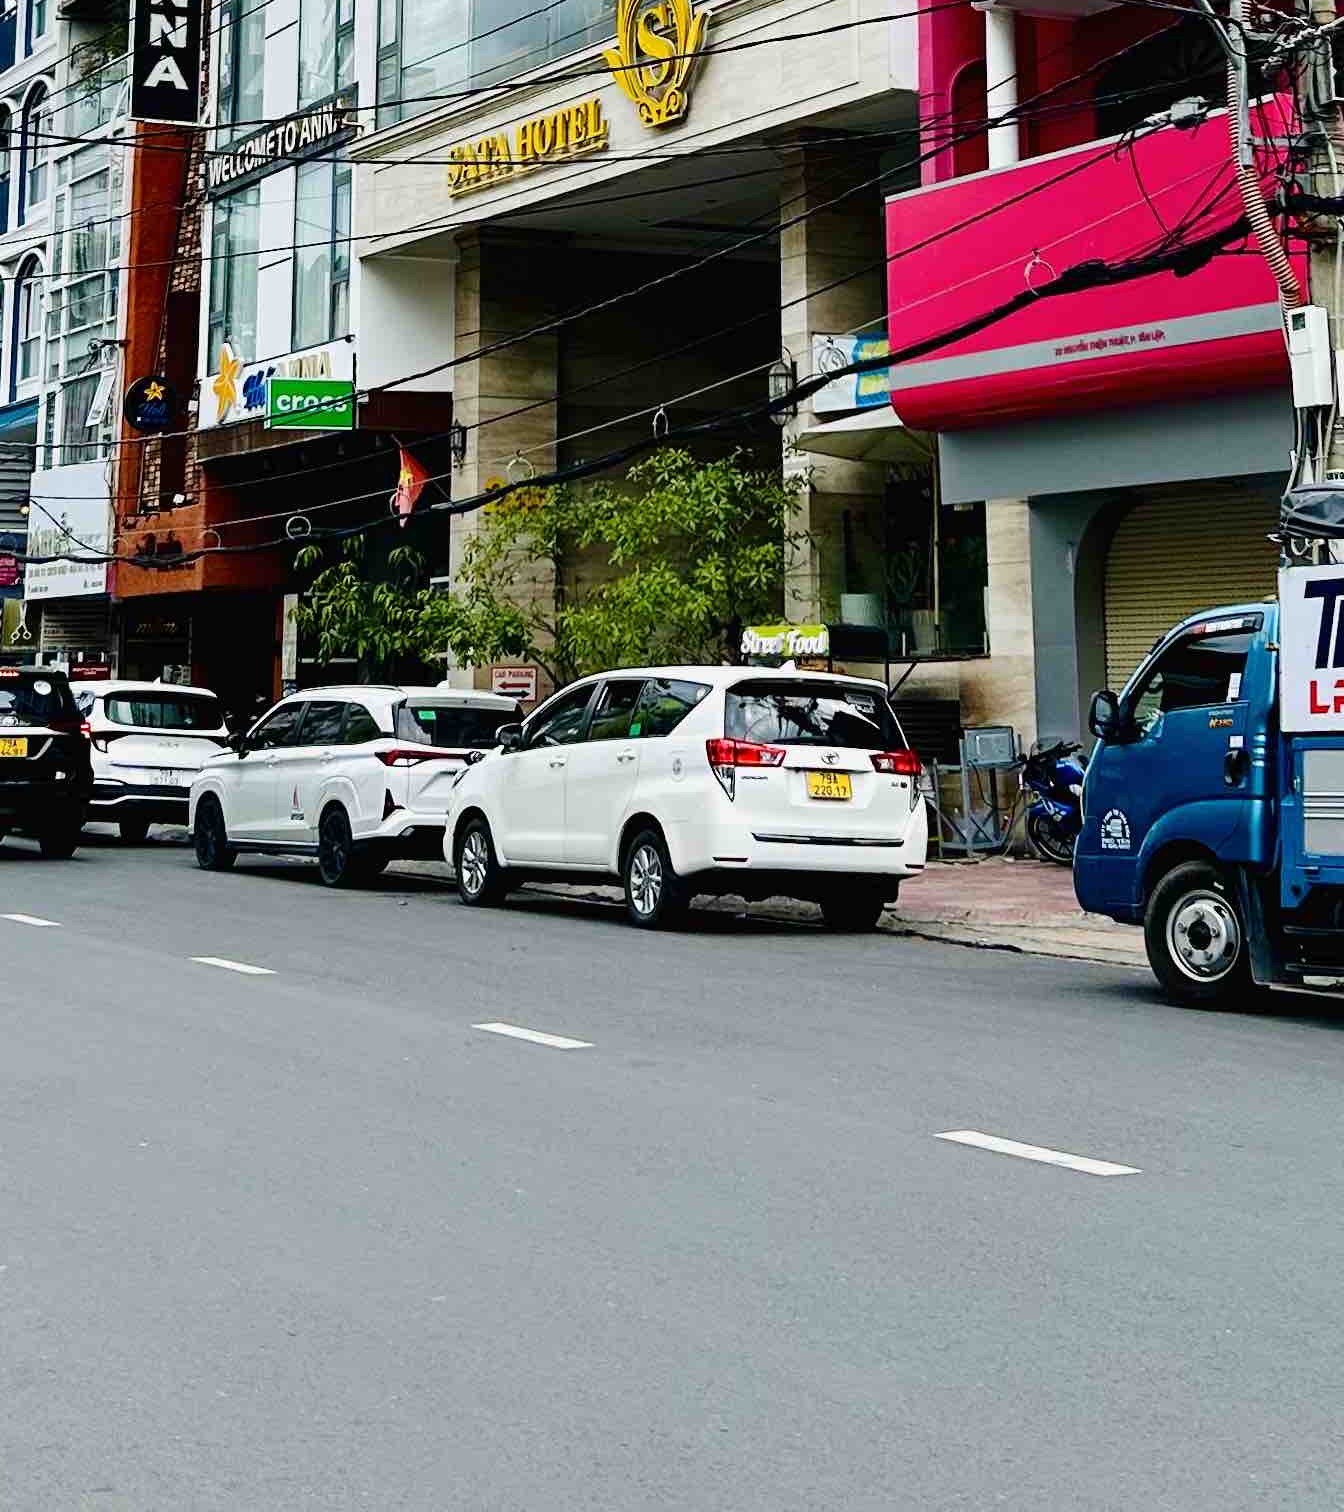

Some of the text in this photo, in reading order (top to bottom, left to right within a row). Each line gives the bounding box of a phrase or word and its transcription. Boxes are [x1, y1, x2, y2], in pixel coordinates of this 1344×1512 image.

[517, 98, 609, 161] HOTEL
[209, 136, 274, 186] WELCOME
[276, 121, 296, 156] TO
[276, 392, 348, 415] crocs
[740, 627, 828, 655] Street Food
[494, 670, 507, 679] CAR
